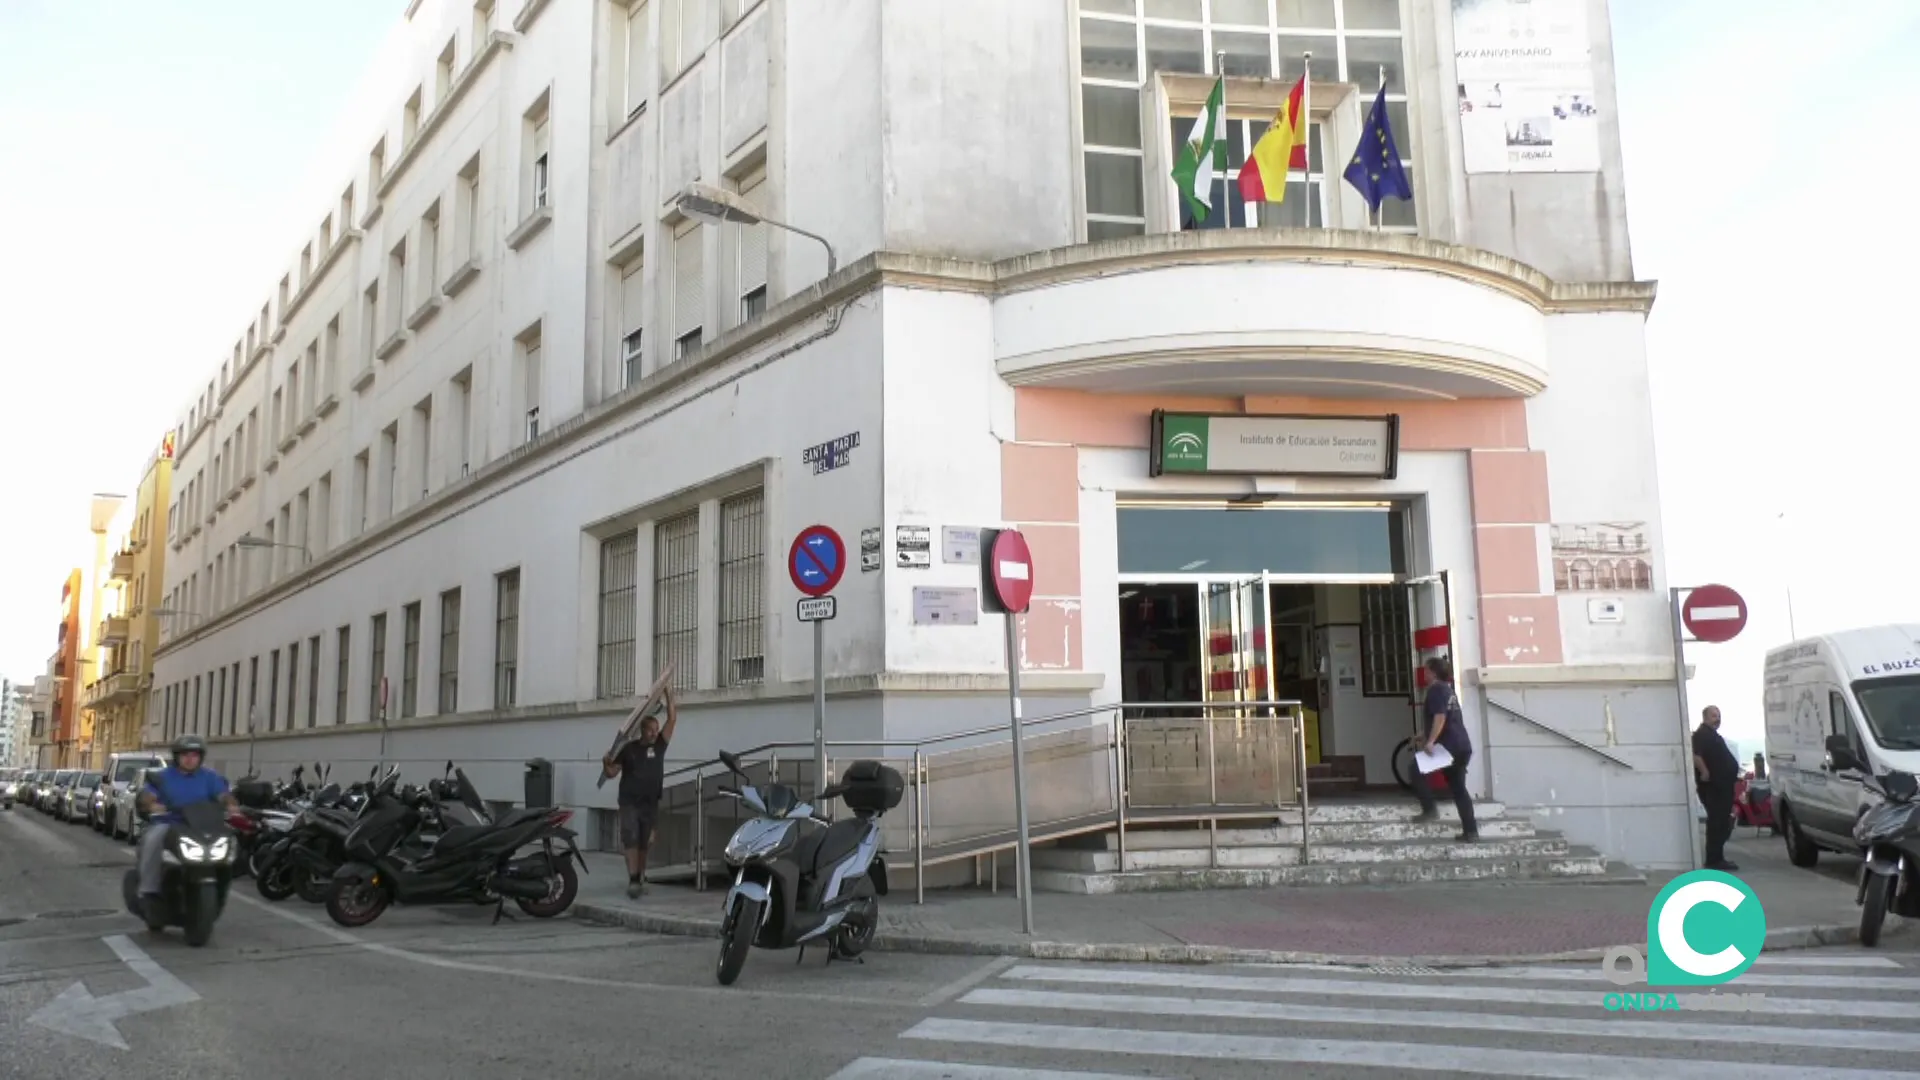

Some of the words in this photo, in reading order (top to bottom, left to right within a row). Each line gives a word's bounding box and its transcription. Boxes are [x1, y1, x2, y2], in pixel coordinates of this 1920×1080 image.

[1480, 47, 1552, 58] ANIVERSARIO
[1240, 434, 1273, 446] Instituto
[1276, 435, 1286, 446] de
[1332, 437, 1377, 447] Secundaria
[803, 444, 828, 464] SANTA
[834, 431, 860, 451] MARIA
[813, 458, 829, 475] DEL
[834, 450, 849, 468] MAR
[801, 601, 832, 610] EXCEPTO
[1863, 665, 1880, 674] EL
